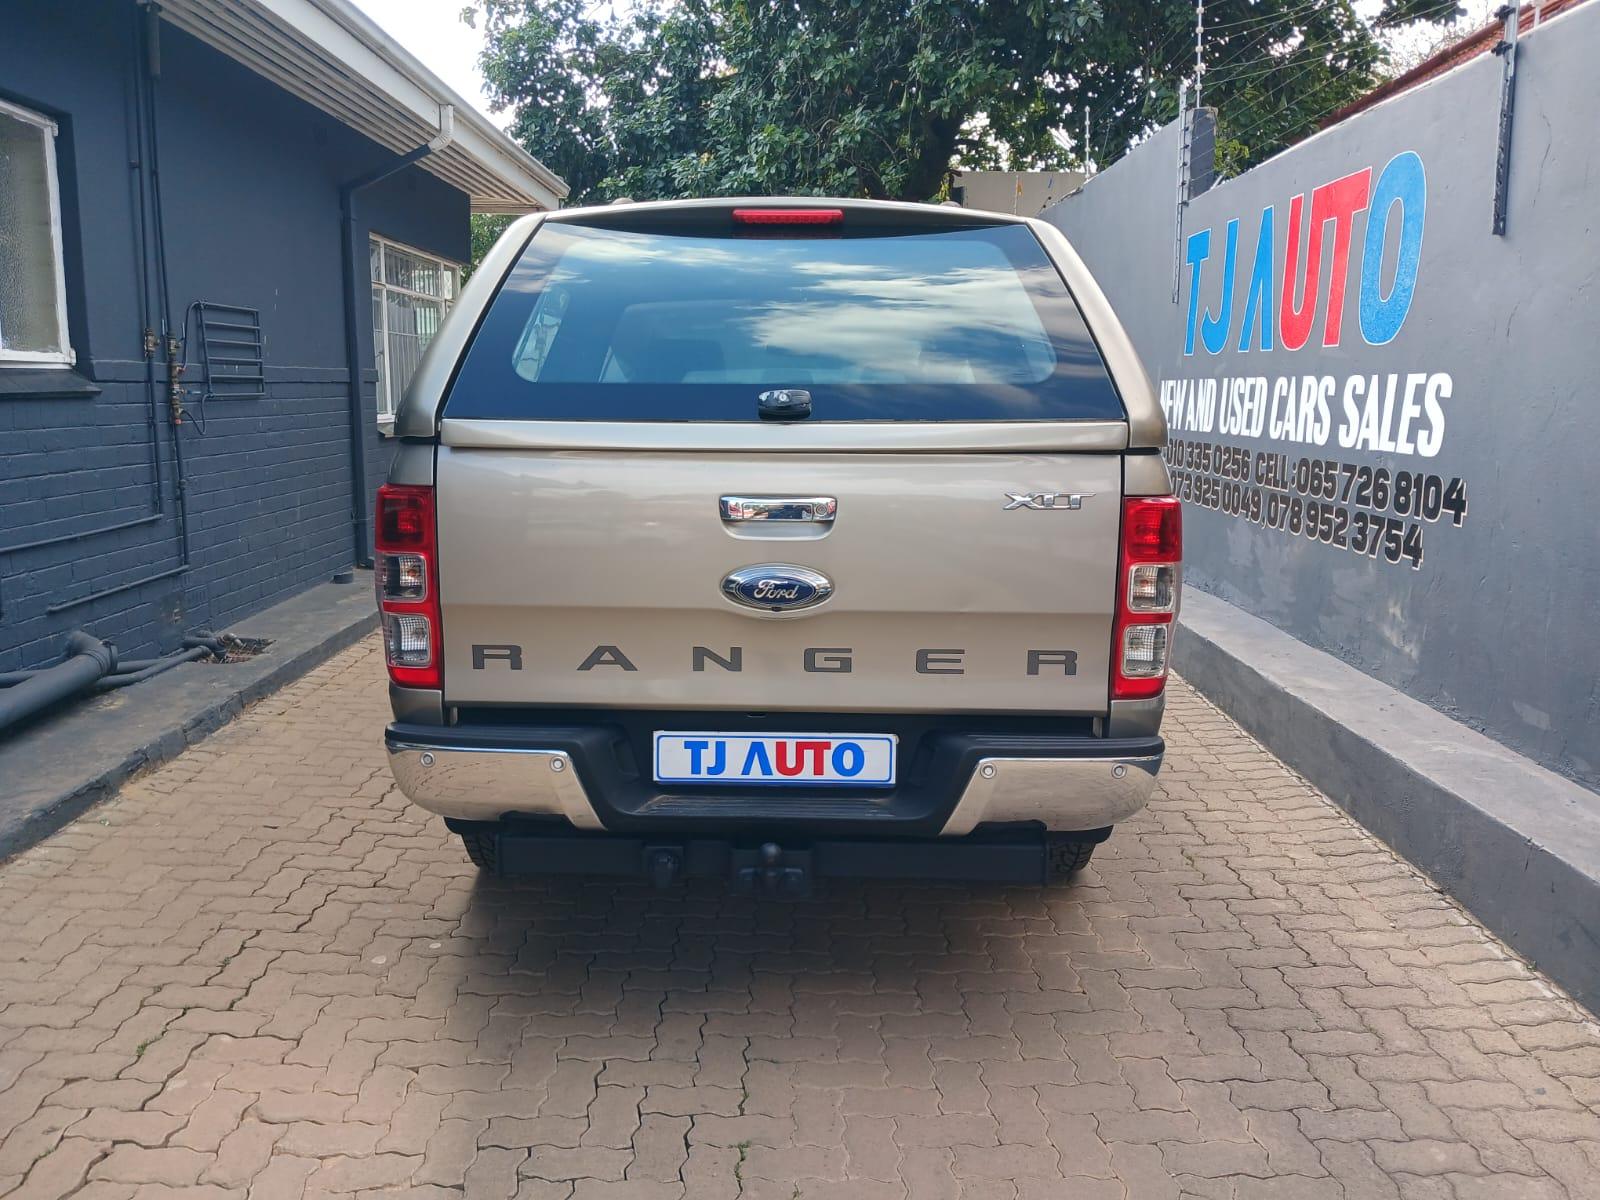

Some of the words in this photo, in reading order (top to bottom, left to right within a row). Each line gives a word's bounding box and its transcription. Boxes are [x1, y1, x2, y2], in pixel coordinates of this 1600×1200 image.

[1184, 217, 1239, 356] TJ
[1238, 150, 1427, 353] AUTO
[1160, 379, 1187, 430] NEW
[1185, 378, 1217, 432] AND
[1219, 376, 1268, 438] USED
[1269, 375, 1336, 447] CARS
[1338, 372, 1453, 458] SALES
[1003, 491, 1096, 510] XLT
[1186, 441, 1212, 474] 335
[1213, 445, 1251, 483] 0256
[1341, 463, 1392, 512] 726
[1394, 470, 1468, 528] 8104
[1193, 474, 1221, 510] 925
[1267, 492, 1304, 536] 078
[1306, 501, 1349, 550] 952
[1351, 511, 1424, 571] 3754
[754, 579, 799, 599] Ford
[472, 644, 1078, 675] RANGER
[683, 740, 727, 776] TJ
[740, 741, 865, 778] AUTO
